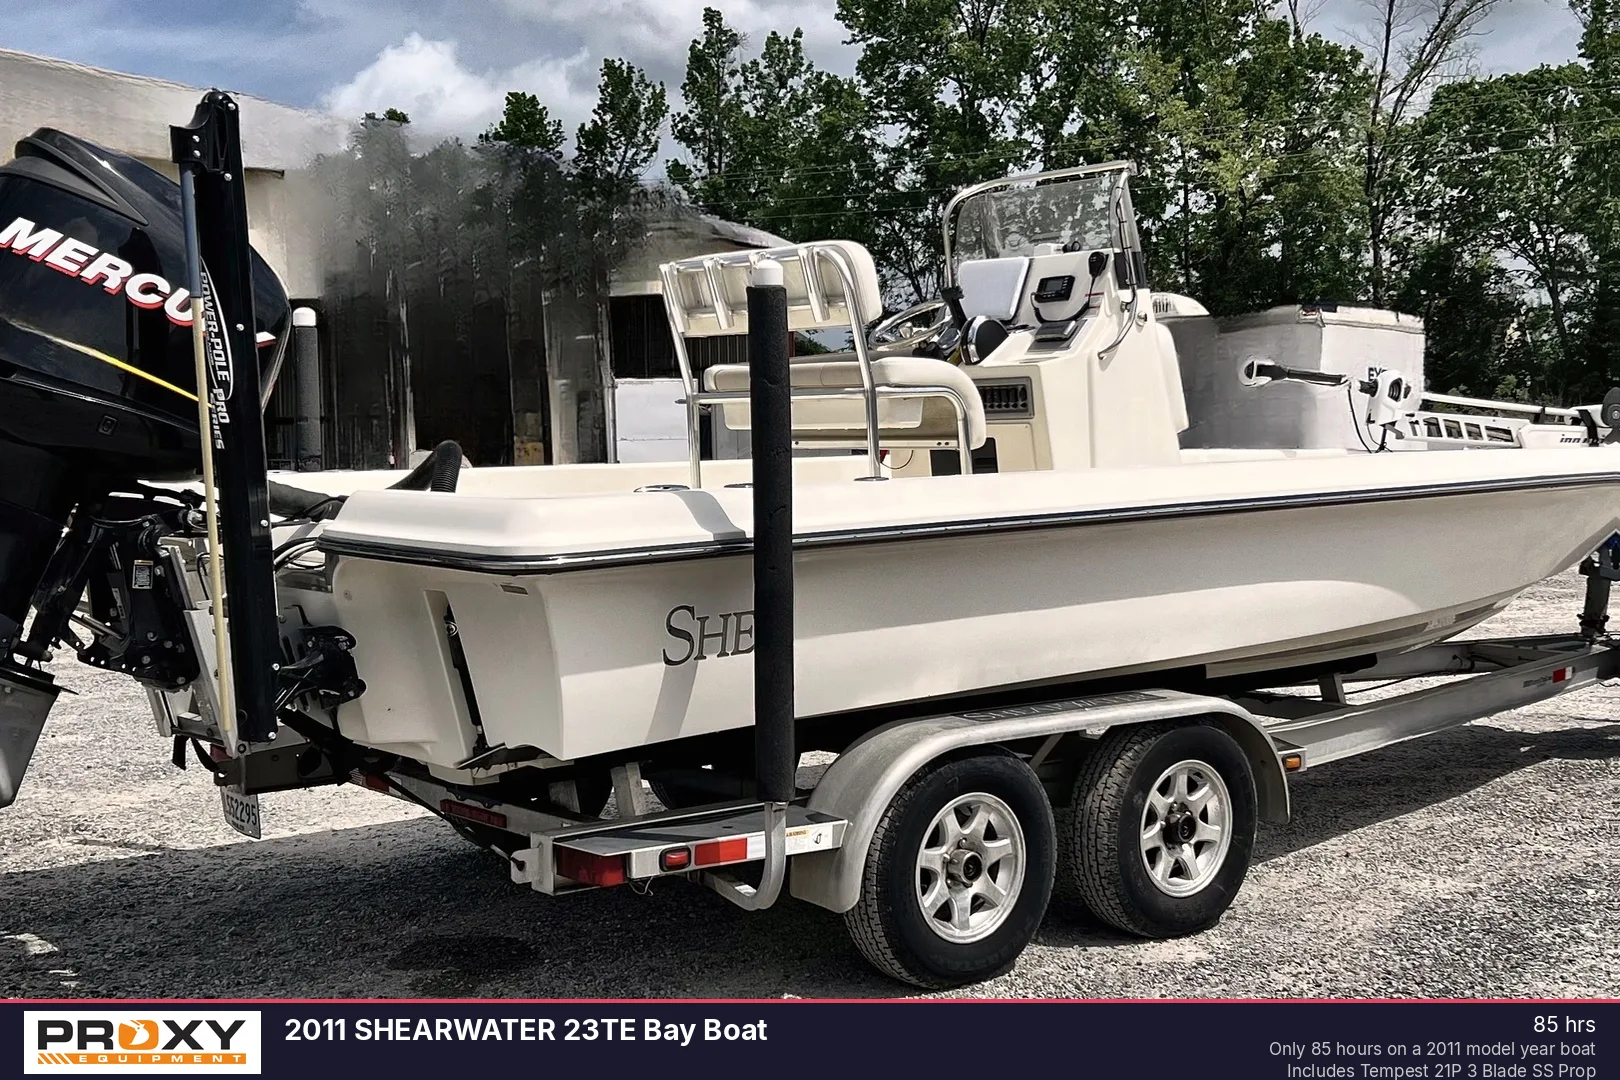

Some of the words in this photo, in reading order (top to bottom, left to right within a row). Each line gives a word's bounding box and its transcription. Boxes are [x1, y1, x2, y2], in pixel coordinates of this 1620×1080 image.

[0, 216, 276, 348] MERCU
[200, 271, 231, 383] POWER-POLE
[212, 387, 231, 425] PRO
